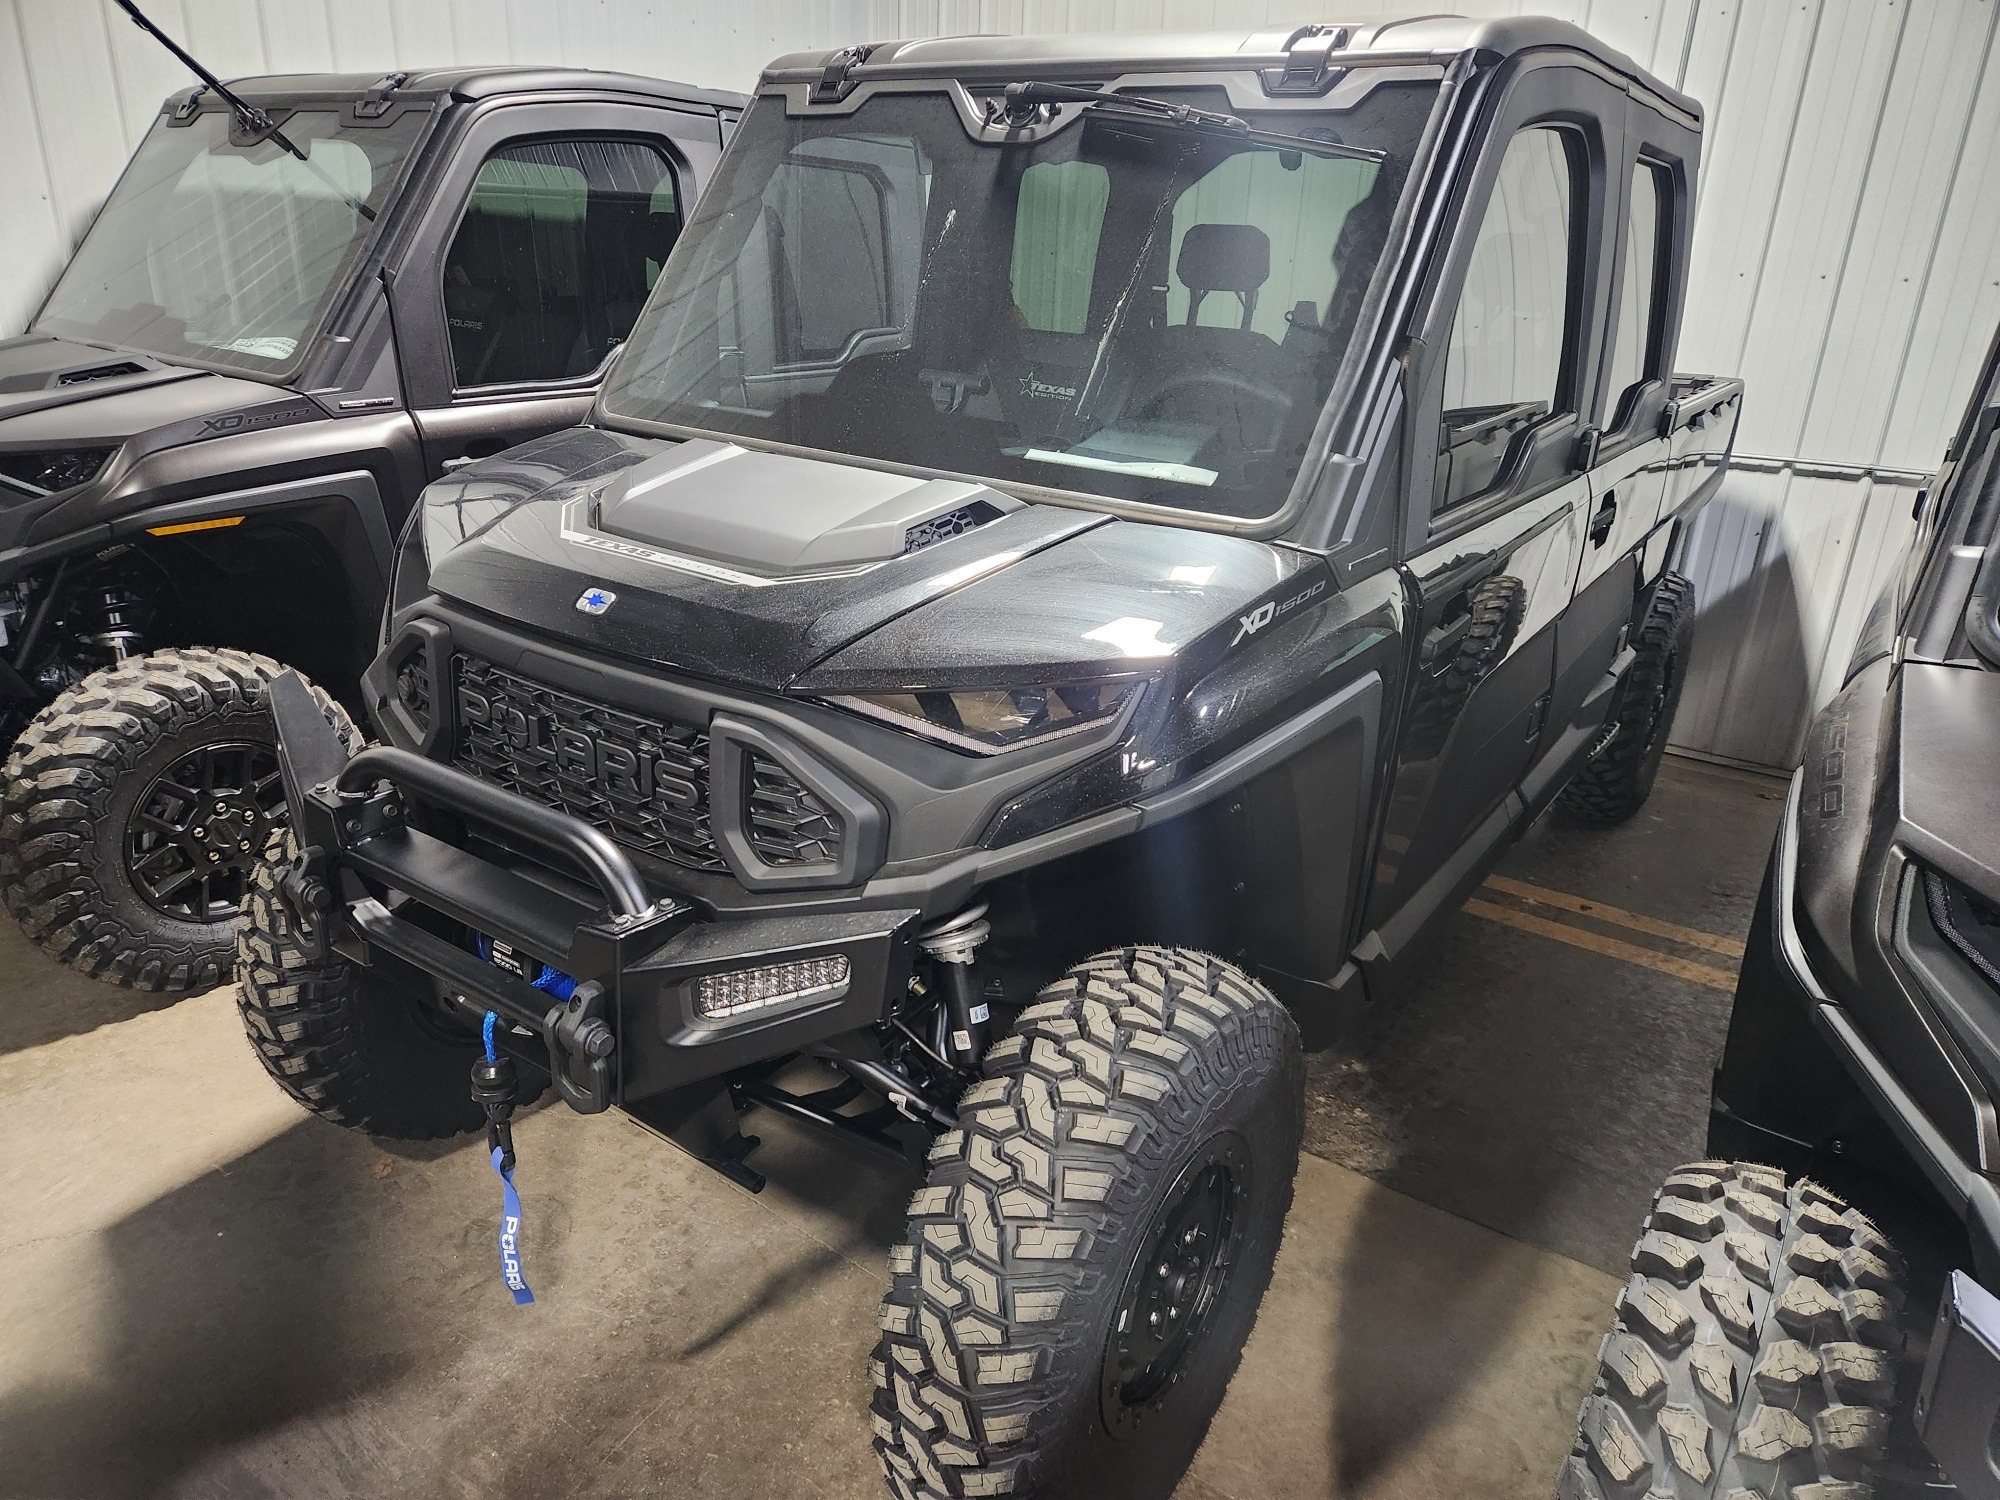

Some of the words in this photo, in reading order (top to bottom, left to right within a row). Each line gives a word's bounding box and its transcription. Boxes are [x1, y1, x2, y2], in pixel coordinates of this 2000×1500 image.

[449, 318, 483, 330] POLARIS
[1030, 382, 1077, 397] TEXAS
[1034, 391, 1072, 401] EDITION
[584, 536, 656, 558] TEXAS
[660, 556, 742, 579] EDITION
[458, 684, 700, 809] POLARIS
[501, 1215, 526, 1291] POLARIS
